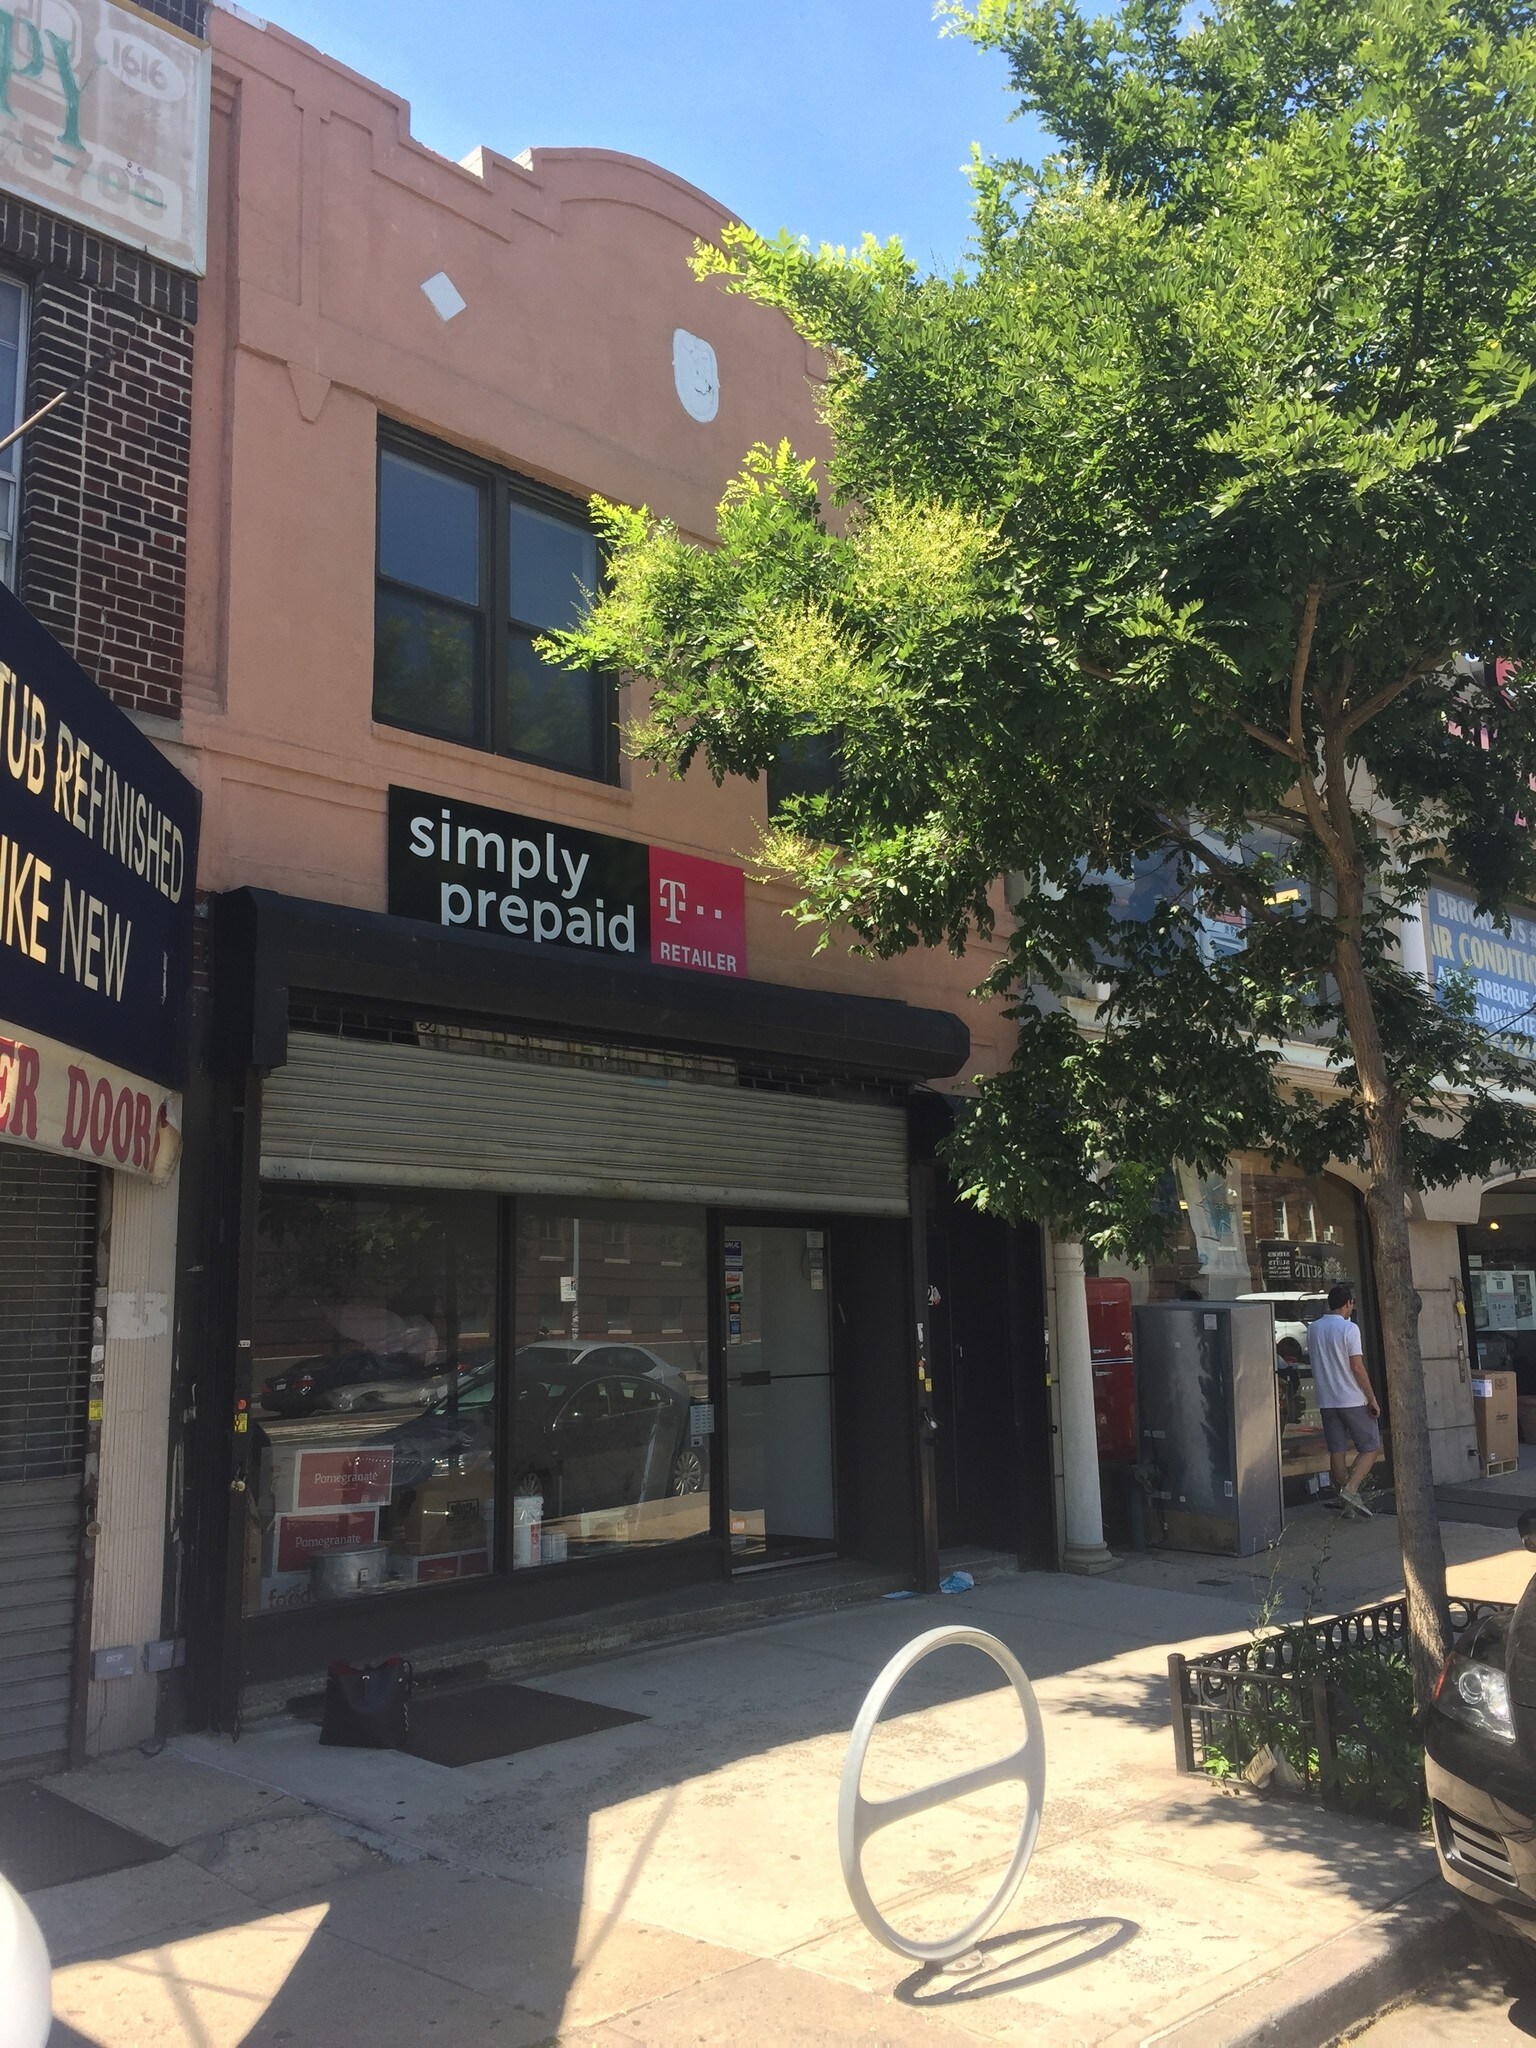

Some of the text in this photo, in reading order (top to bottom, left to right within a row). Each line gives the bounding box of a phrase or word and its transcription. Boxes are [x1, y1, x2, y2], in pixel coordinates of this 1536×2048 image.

[112, 38, 169, 91] 1616
[54, 720, 184, 904] REFINISHED
[409, 808, 590, 900] simply
[60, 878, 132, 1003] NEW
[440, 882, 636, 952] prepaid
[1437, 892, 1526, 944] BROOKL'S
[660, 942, 737, 973] RETAILER
[313, 1471, 379, 1486] Pomegranate
[295, 1534, 361, 1549] Pomegranate
